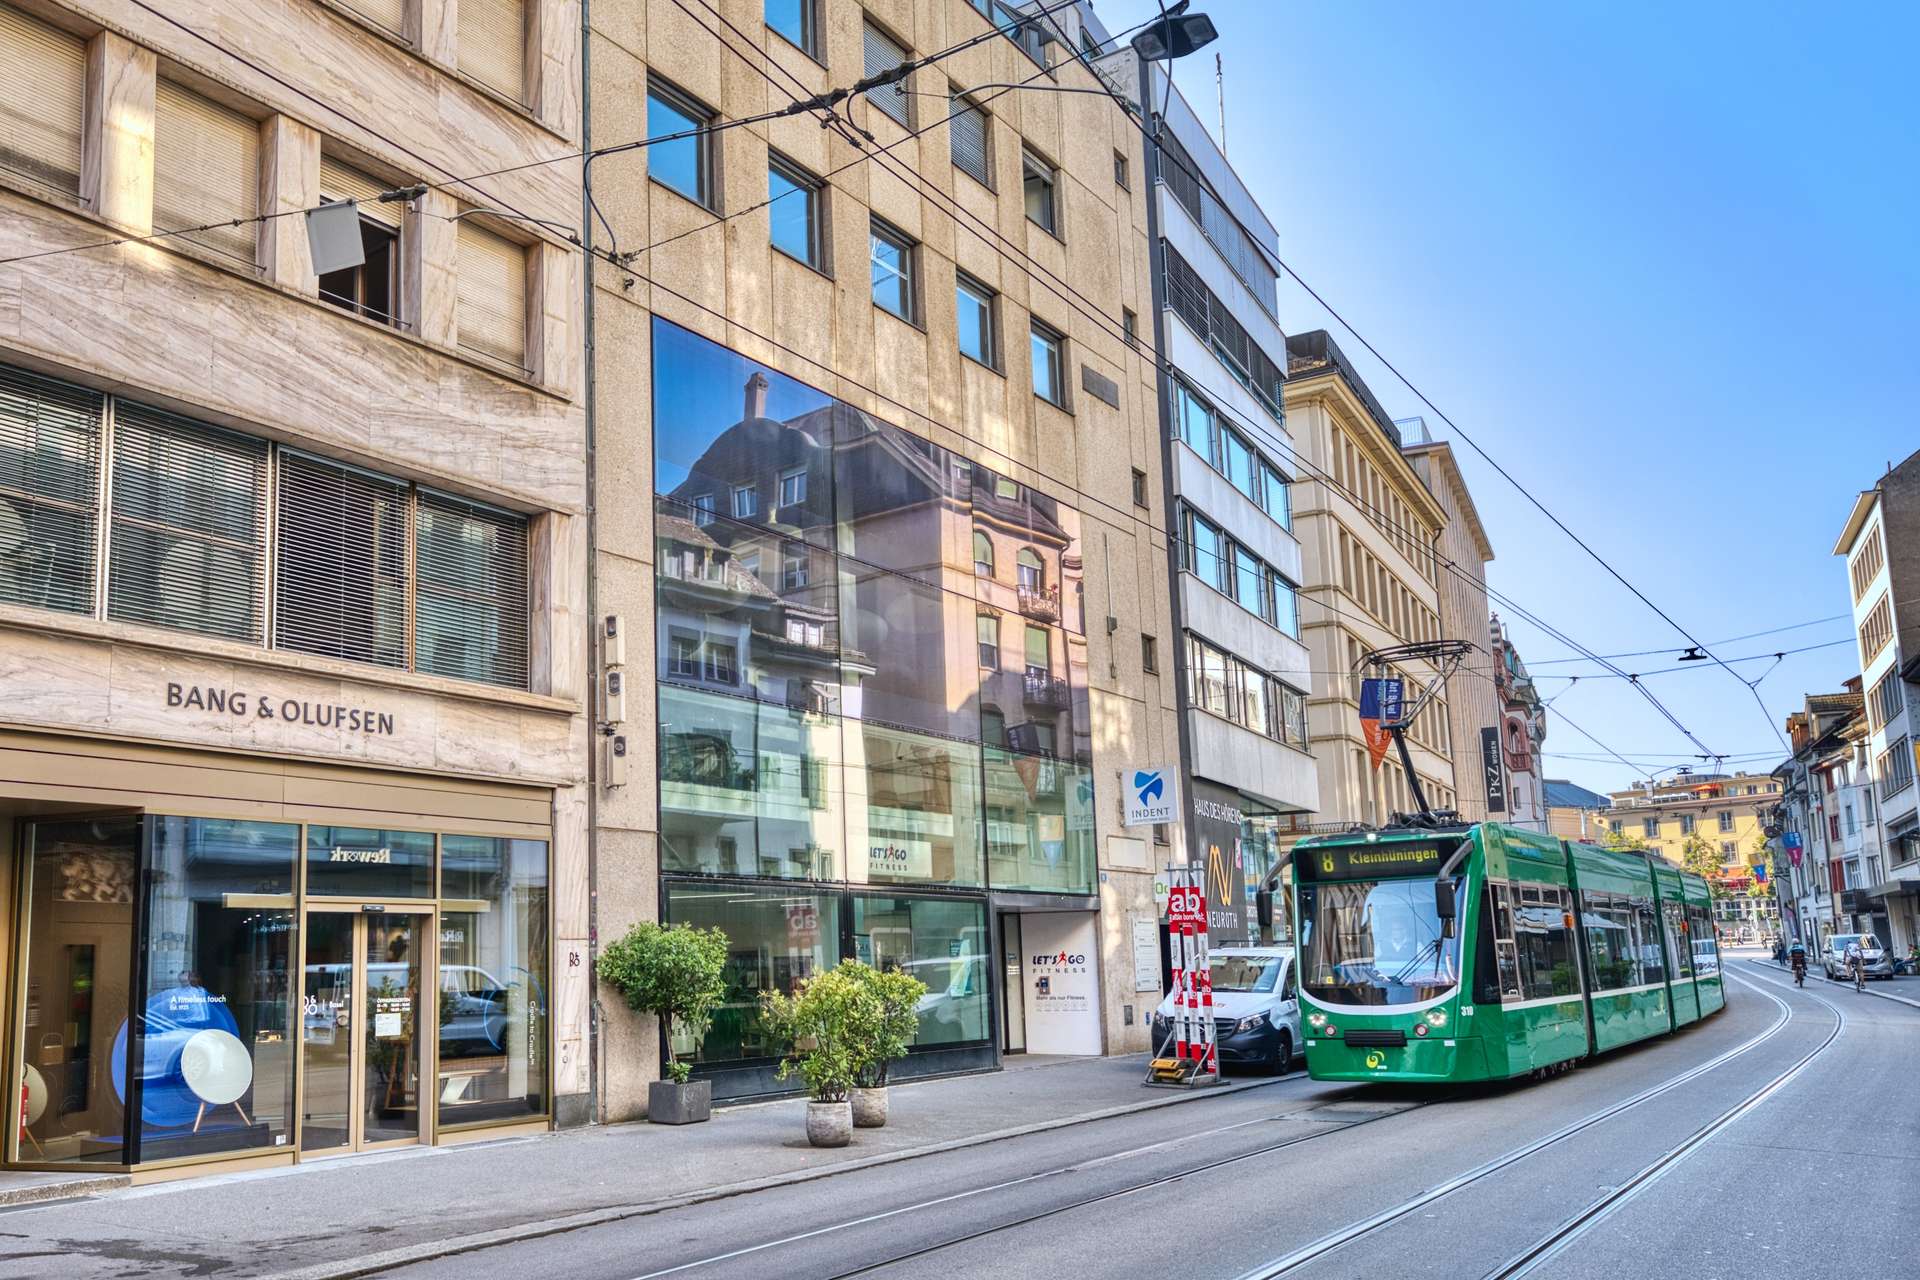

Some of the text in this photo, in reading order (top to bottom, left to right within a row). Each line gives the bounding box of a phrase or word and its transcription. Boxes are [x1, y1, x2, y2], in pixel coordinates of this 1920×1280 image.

[167, 682, 394, 735] BANG & OLUFSEN
[1488, 740, 1502, 799] PKZ WOMEN
[1132, 807, 1170, 818] INDENT
[1193, 797, 1209, 817] HAUS
[1209, 801, 1221, 821] DES
[870, 845, 907, 861] LET'S GO
[1322, 848, 1439, 873] 8 Kleinhüningen
[870, 862, 908, 871] FITNESS
[1171, 888, 1200, 912] ab
[1206, 910, 1238, 929] NEUROTH
[1032, 954, 1085, 965] LET'S GO
[207, 993, 227, 1003] touch
[329, 1000, 344, 1009] Basel
